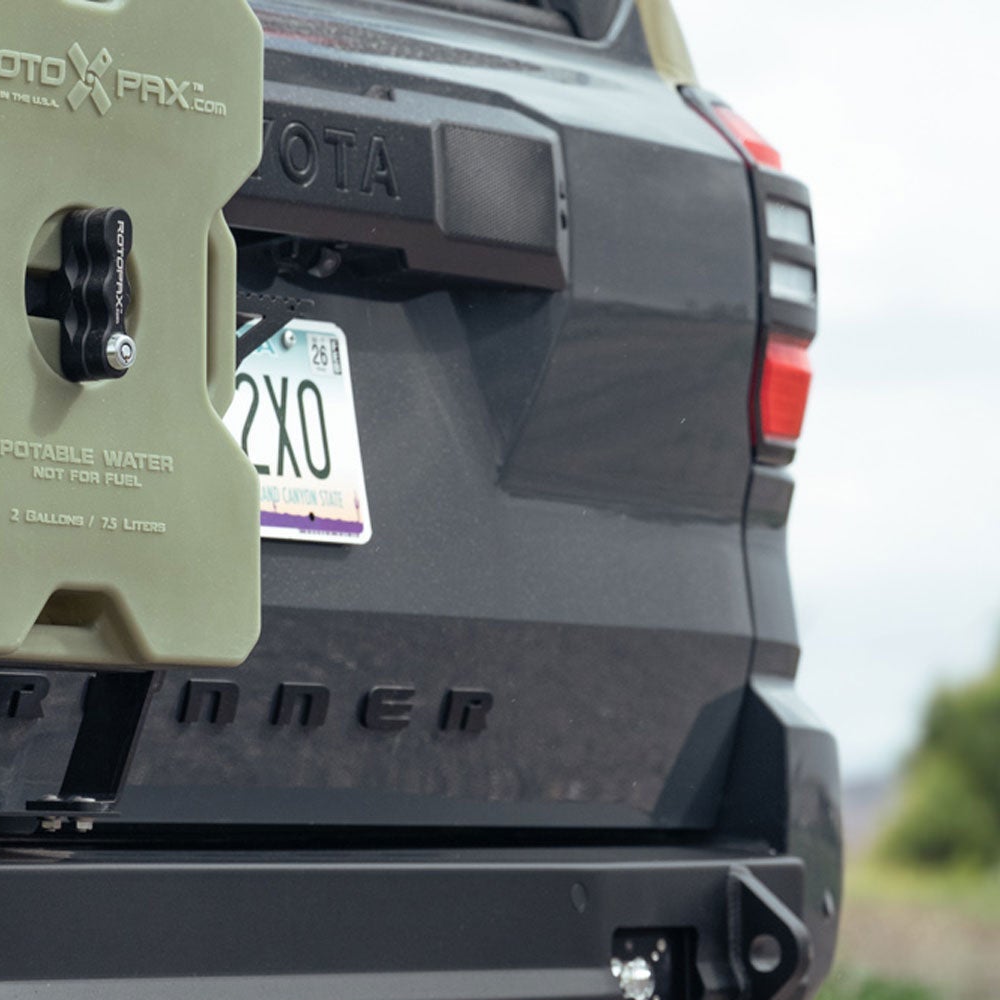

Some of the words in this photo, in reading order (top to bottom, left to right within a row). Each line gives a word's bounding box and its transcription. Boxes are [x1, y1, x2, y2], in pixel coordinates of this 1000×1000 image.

[0, 90, 10, 99] IN
[12, 92, 30, 103] THE
[250, 119, 401, 200] OTA
[311, 343, 329, 366] 26
[0, 439, 95, 465] POTABLE
[103, 450, 174, 473] WATER
[33, 466, 65, 481] NOT
[70, 470, 100, 485] FOR
[104, 473, 143, 488] FUEL
[282, 487, 318, 505] CANYON
[319, 490, 344, 508] STATE
[10, 508, 20, 522] 2
[25, 510, 85, 526] GALLONS
